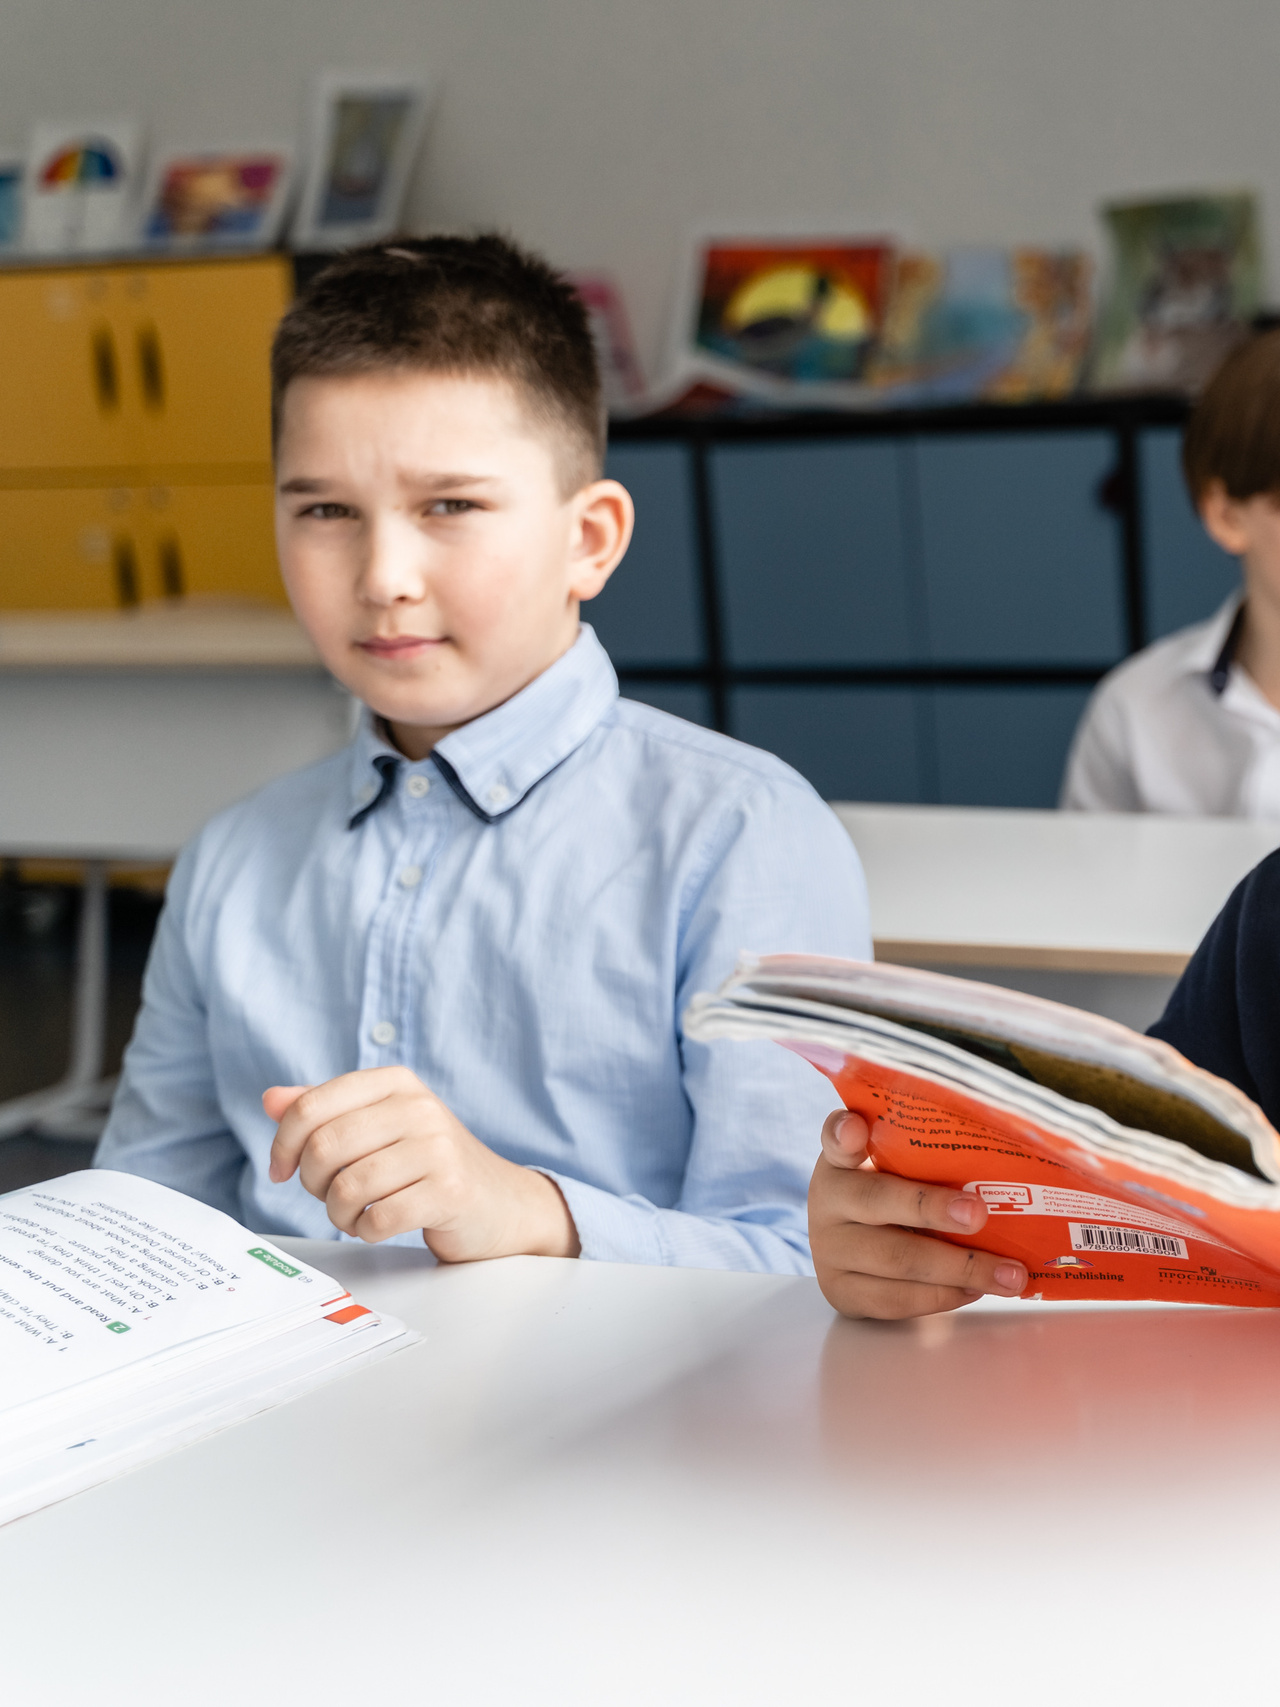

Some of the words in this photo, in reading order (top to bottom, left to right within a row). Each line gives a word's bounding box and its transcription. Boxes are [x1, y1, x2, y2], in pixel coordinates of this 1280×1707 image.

[884, 1094, 937, 1113] Рабочие
[889, 1117, 925, 1134] Книга
[909, 1138, 1032, 1160] Интернет-сайт
[74, 1217, 105, 1231] about
[99, 1215, 118, 1225] eat
[138, 1221, 159, 1233] like
[39, 1227, 58, 1236] the
[104, 1231, 131, 1245] book
[118, 1224, 161, 1248] Dolphins
[158, 1231, 181, 1243] you
[68, 1240, 107, 1259] picture
[104, 1245, 130, 1259] fish!
[178, 1241, 193, 1251] Do
[27, 1249, 63, 1266] doing?
[139, 1248, 177, 1271] reading
[158, 1247, 198, 1268] course!
[191, 1250, 228, 1273] Really?
[262, 1253, 297, 1276] Module
[62, 1266, 85, 1279] you
[73, 1257, 101, 1274] think
[103, 1258, 125, 1273] that
[194, 1266, 211, 1277] Of
[22, 1269, 42, 1281] the
[125, 1271, 139, 1280] at
[137, 1262, 179, 1288] catching
[209, 1277, 225, 1286] B:
[226, 1273, 241, 1281] A:
[298, 1276, 313, 1284] 60
[1065, 1271, 1124, 1282] Publishing
[42, 1280, 65, 1293] put
[82, 1278, 101, 1290] are
[105, 1277, 132, 1291] yes!
[137, 1279, 163, 1294] Look
[195, 1281, 209, 1290] B:
[60, 1292, 84, 1306] and
[100, 1289, 127, 1307] What
[129, 1290, 145, 1301] Oh
[162, 1293, 177, 1301] A:
[128, 1305, 143, 1314] A:
[145, 1300, 159, 1308] B:
[81, 1305, 112, 1323] Read
[14, 1318, 42, 1337] What
[60, 1330, 75, 1340] B:
